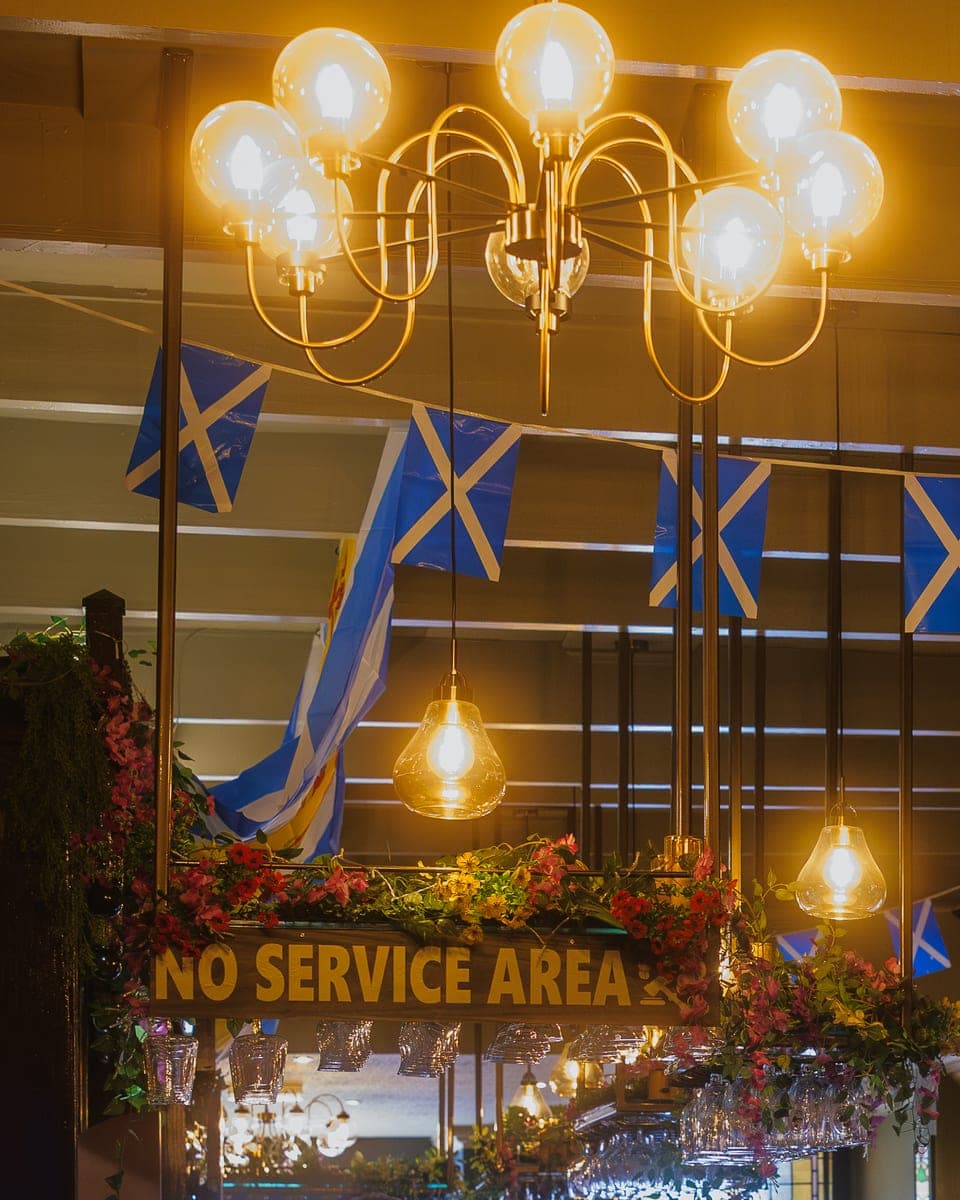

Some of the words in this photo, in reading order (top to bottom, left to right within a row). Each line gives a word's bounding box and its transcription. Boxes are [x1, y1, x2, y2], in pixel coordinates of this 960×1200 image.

[154, 938, 238, 1002] NO
[255, 942, 472, 1004] SERVICE
[487, 946, 632, 1007] AREA
